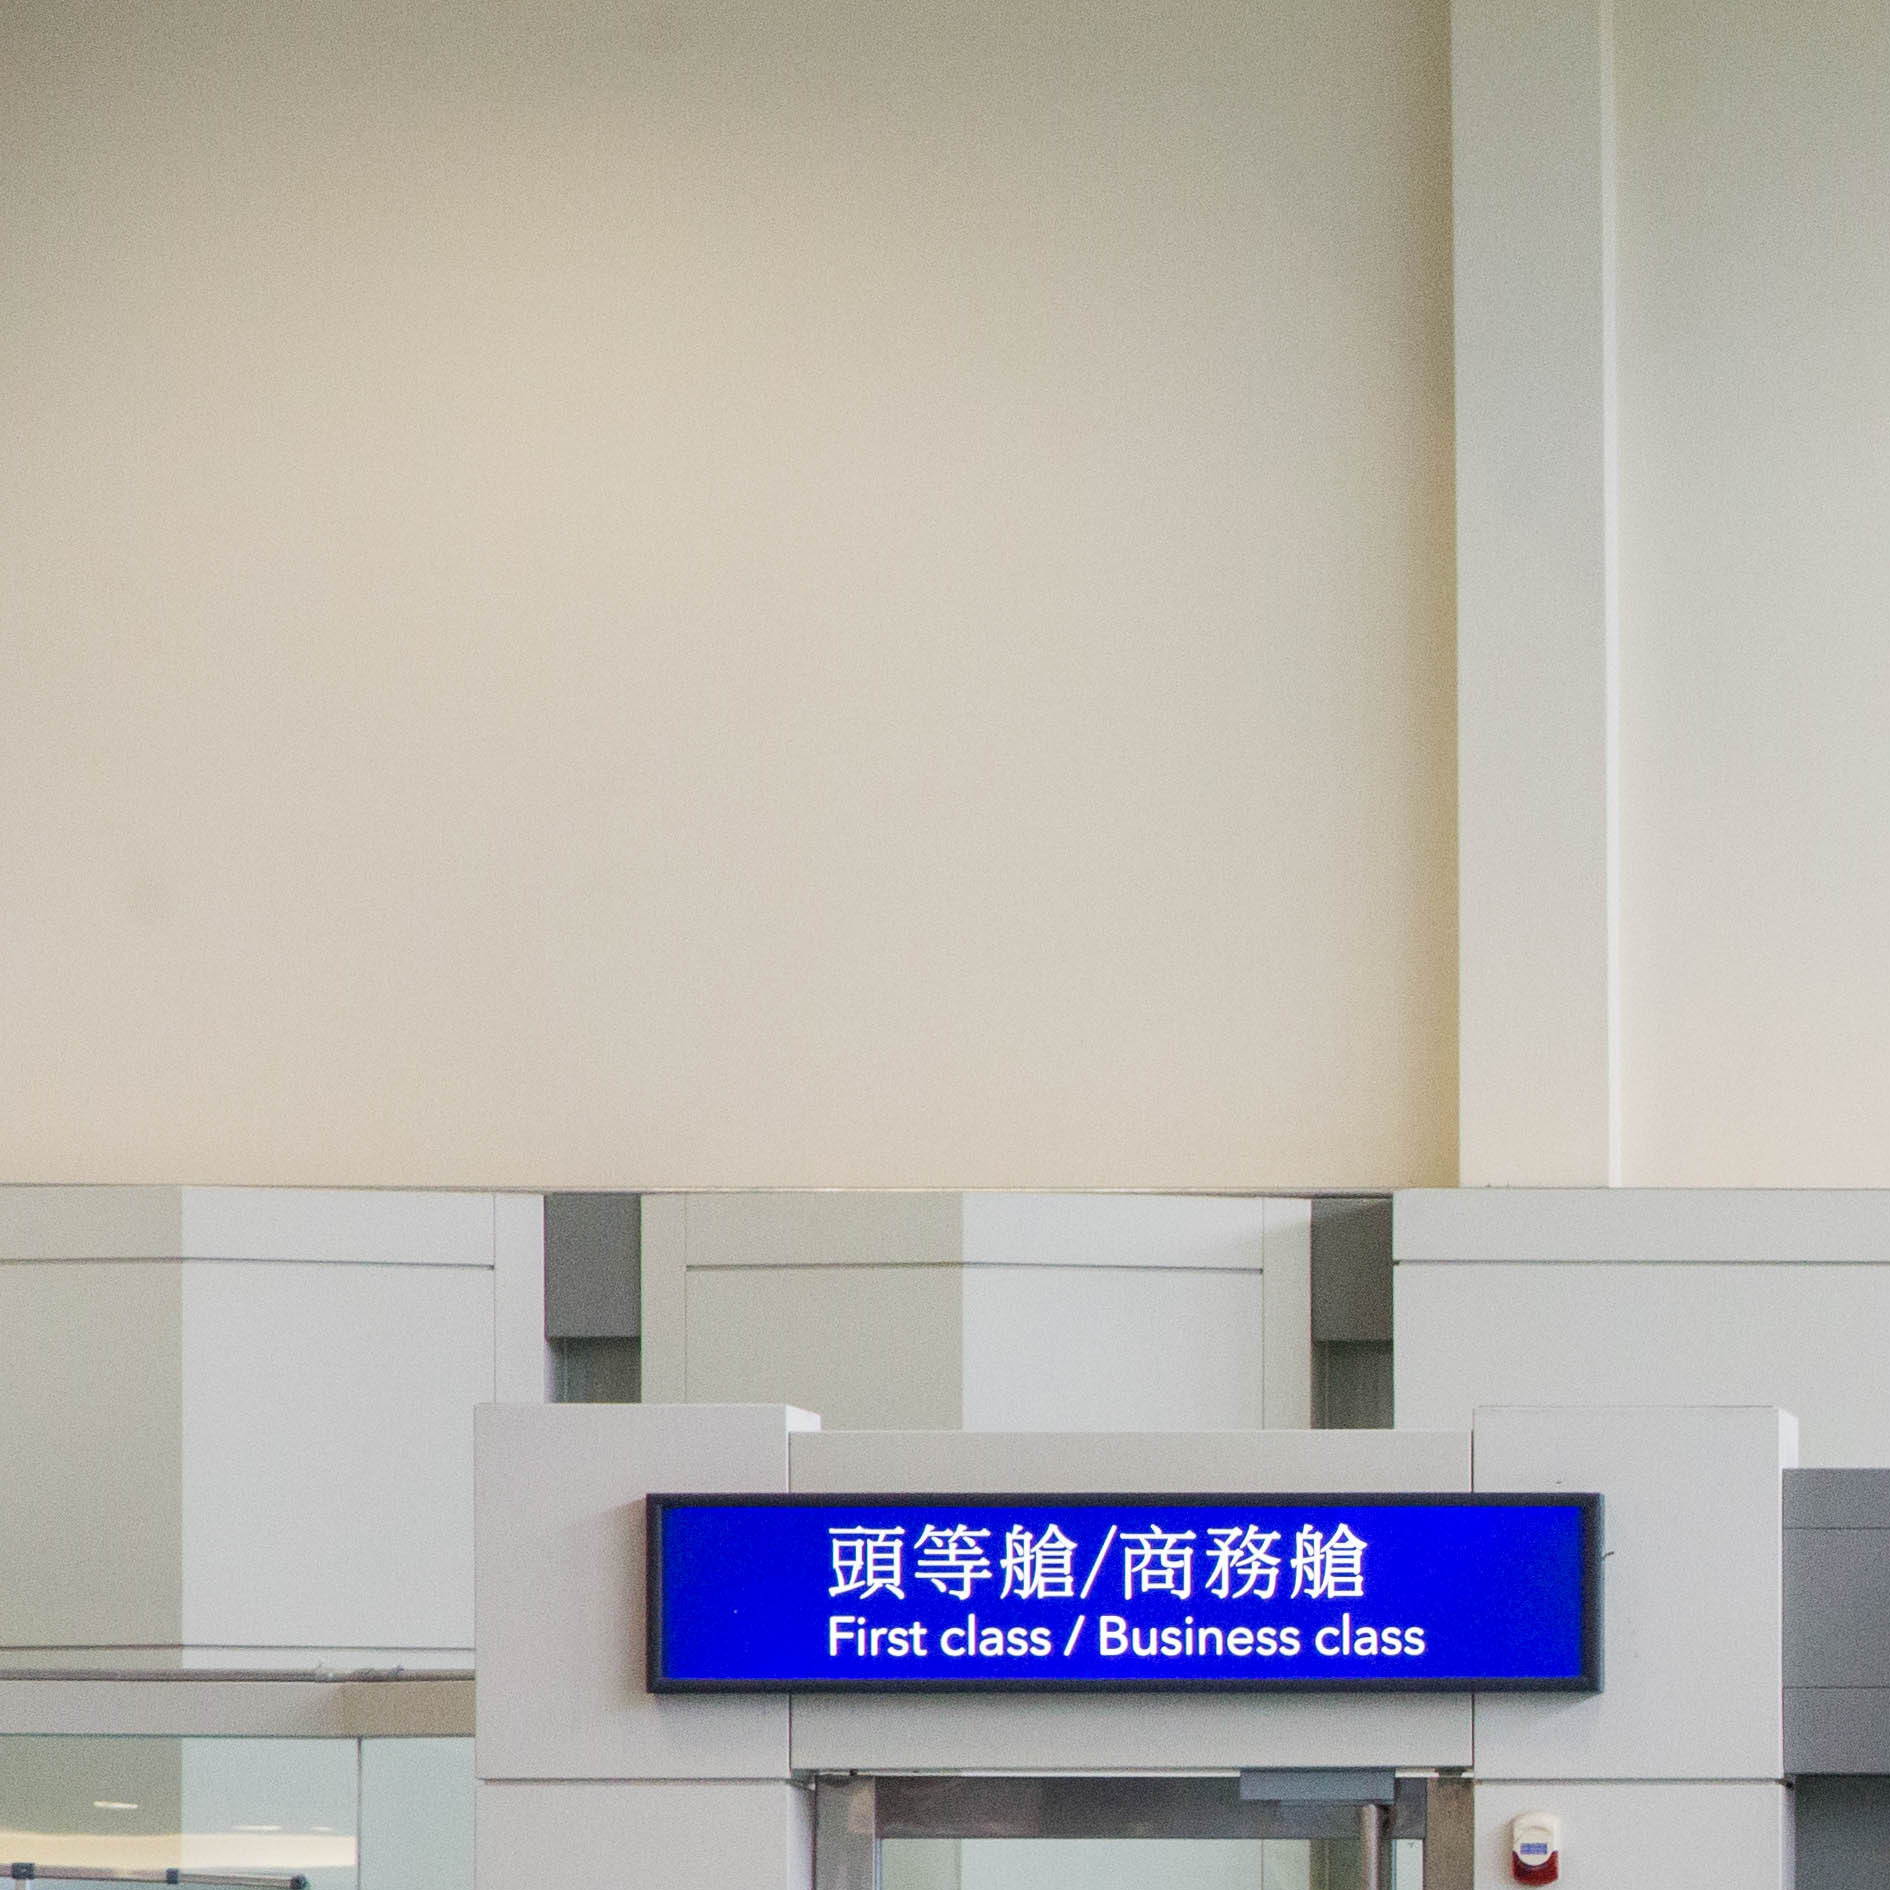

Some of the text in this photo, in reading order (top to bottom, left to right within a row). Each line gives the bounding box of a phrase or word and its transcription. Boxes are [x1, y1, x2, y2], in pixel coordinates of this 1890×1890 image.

[829, 1523, 1368, 1602] 頭等艙/商務艙
[829, 1614, 927, 1656] First
[939, 1614, 1051, 1656] class
[1098, 1614, 1300, 1656] Business
[1315, 1614, 1425, 1656] class
